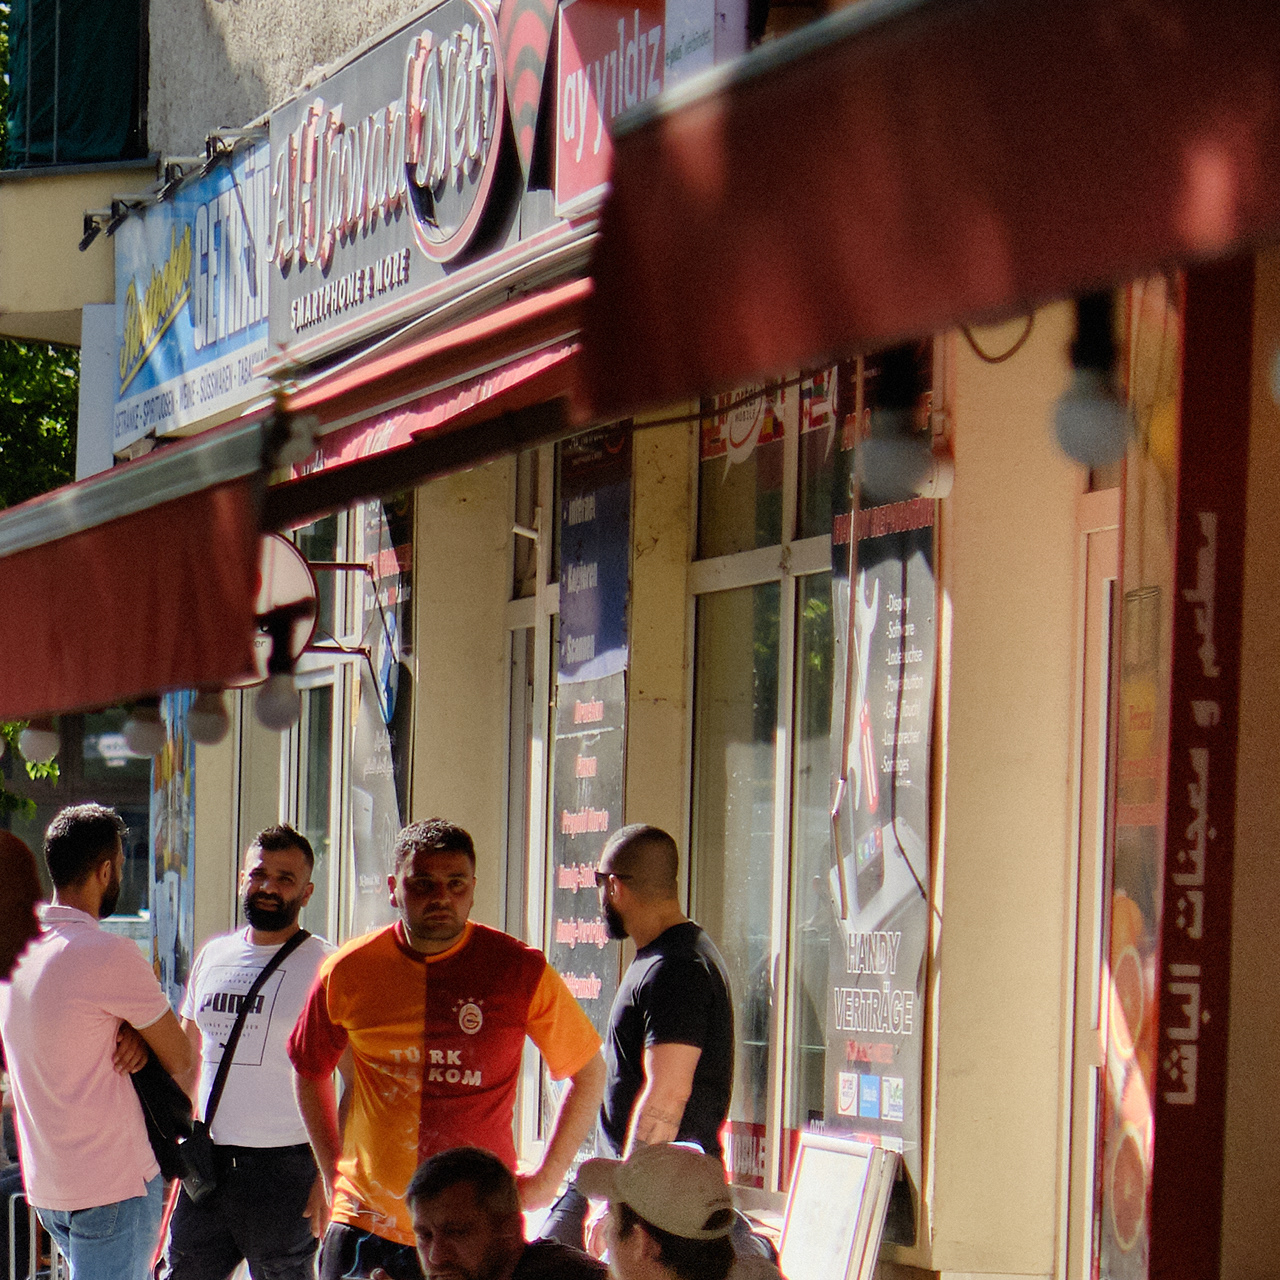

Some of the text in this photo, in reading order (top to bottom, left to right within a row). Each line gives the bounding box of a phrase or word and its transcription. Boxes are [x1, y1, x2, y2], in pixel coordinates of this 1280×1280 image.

[416, 22, 491, 188] Net
[563, 64, 590, 162] ay
[290, 268, 362, 331] SMARTPHONE
[375, 248, 410, 292] MORE
[199, 366, 233, 403] SÜSSWAREN
[1188, 698, 1221, 729] و
[1170, 747, 1218, 940] معجنات
[846, 931, 902, 975] HANDY
[200, 992, 265, 1014] PUMA
[834, 981, 914, 1035] VERTRÄGE
[390, 1046, 462, 1066] TÜRK
[1161, 962, 1212, 1107] الباشا
